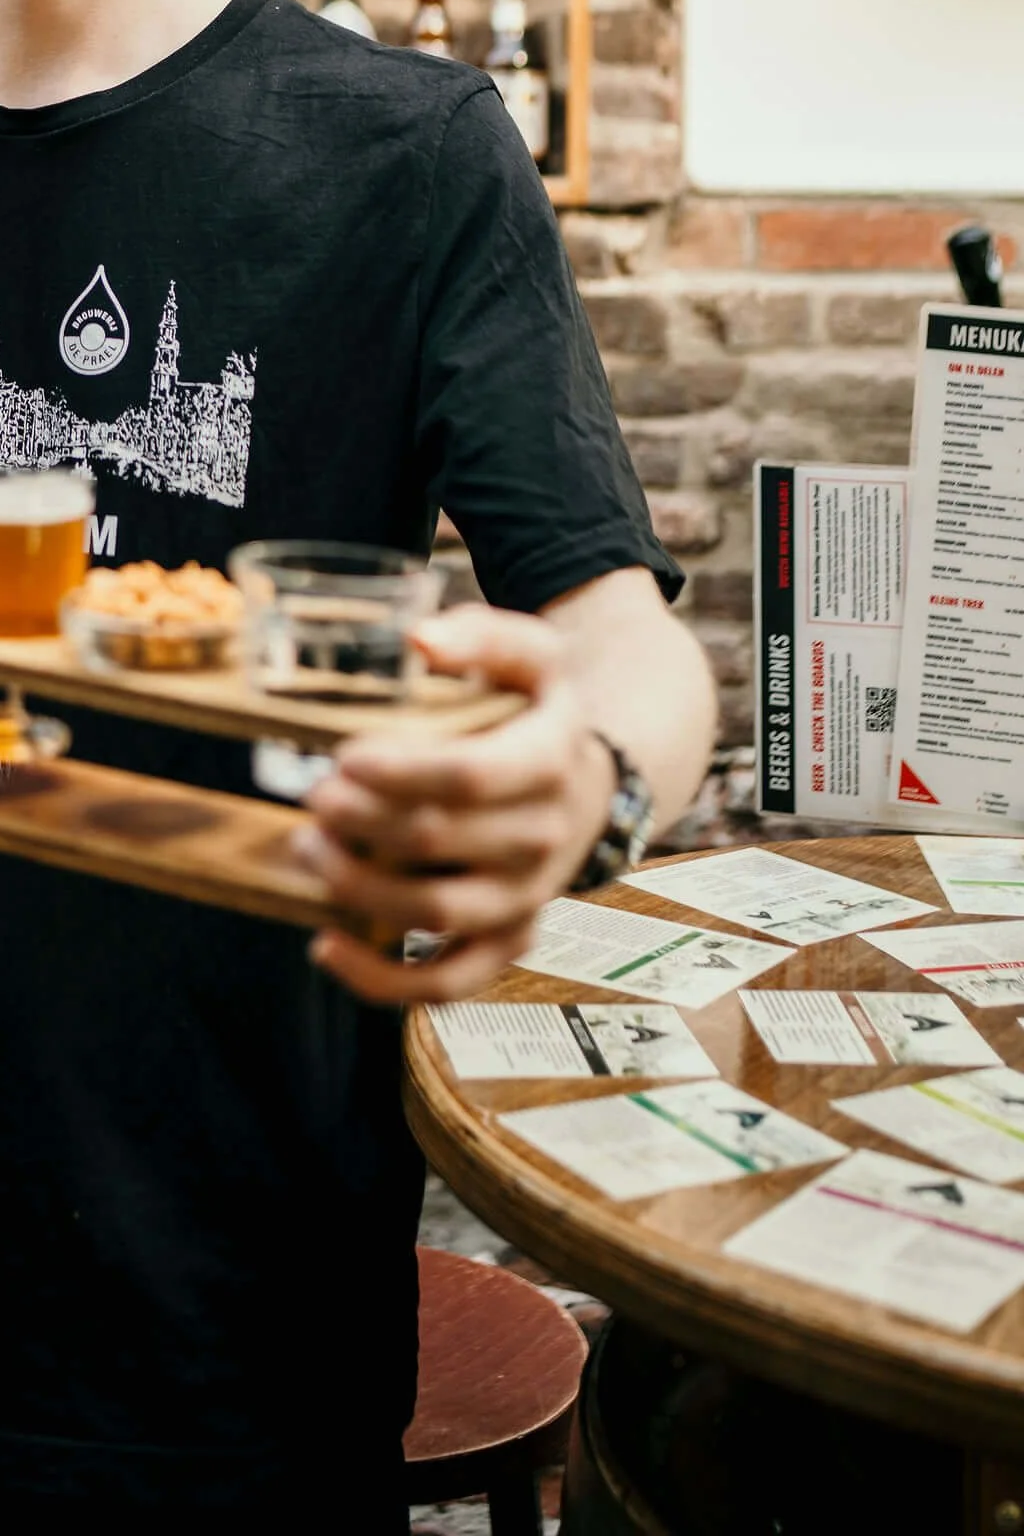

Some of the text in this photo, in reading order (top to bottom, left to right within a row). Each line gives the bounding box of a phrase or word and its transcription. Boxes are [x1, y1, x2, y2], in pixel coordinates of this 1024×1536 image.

[72, 309, 118, 332] BROUWERIJ
[949, 324, 1024, 353] MENUK
[69, 343, 117, 366] DE PRAEL
[768, 634, 791, 792] BEERS & DRINKS
[812, 716, 824, 752] CHECK
[812, 764, 824, 792] BEER
